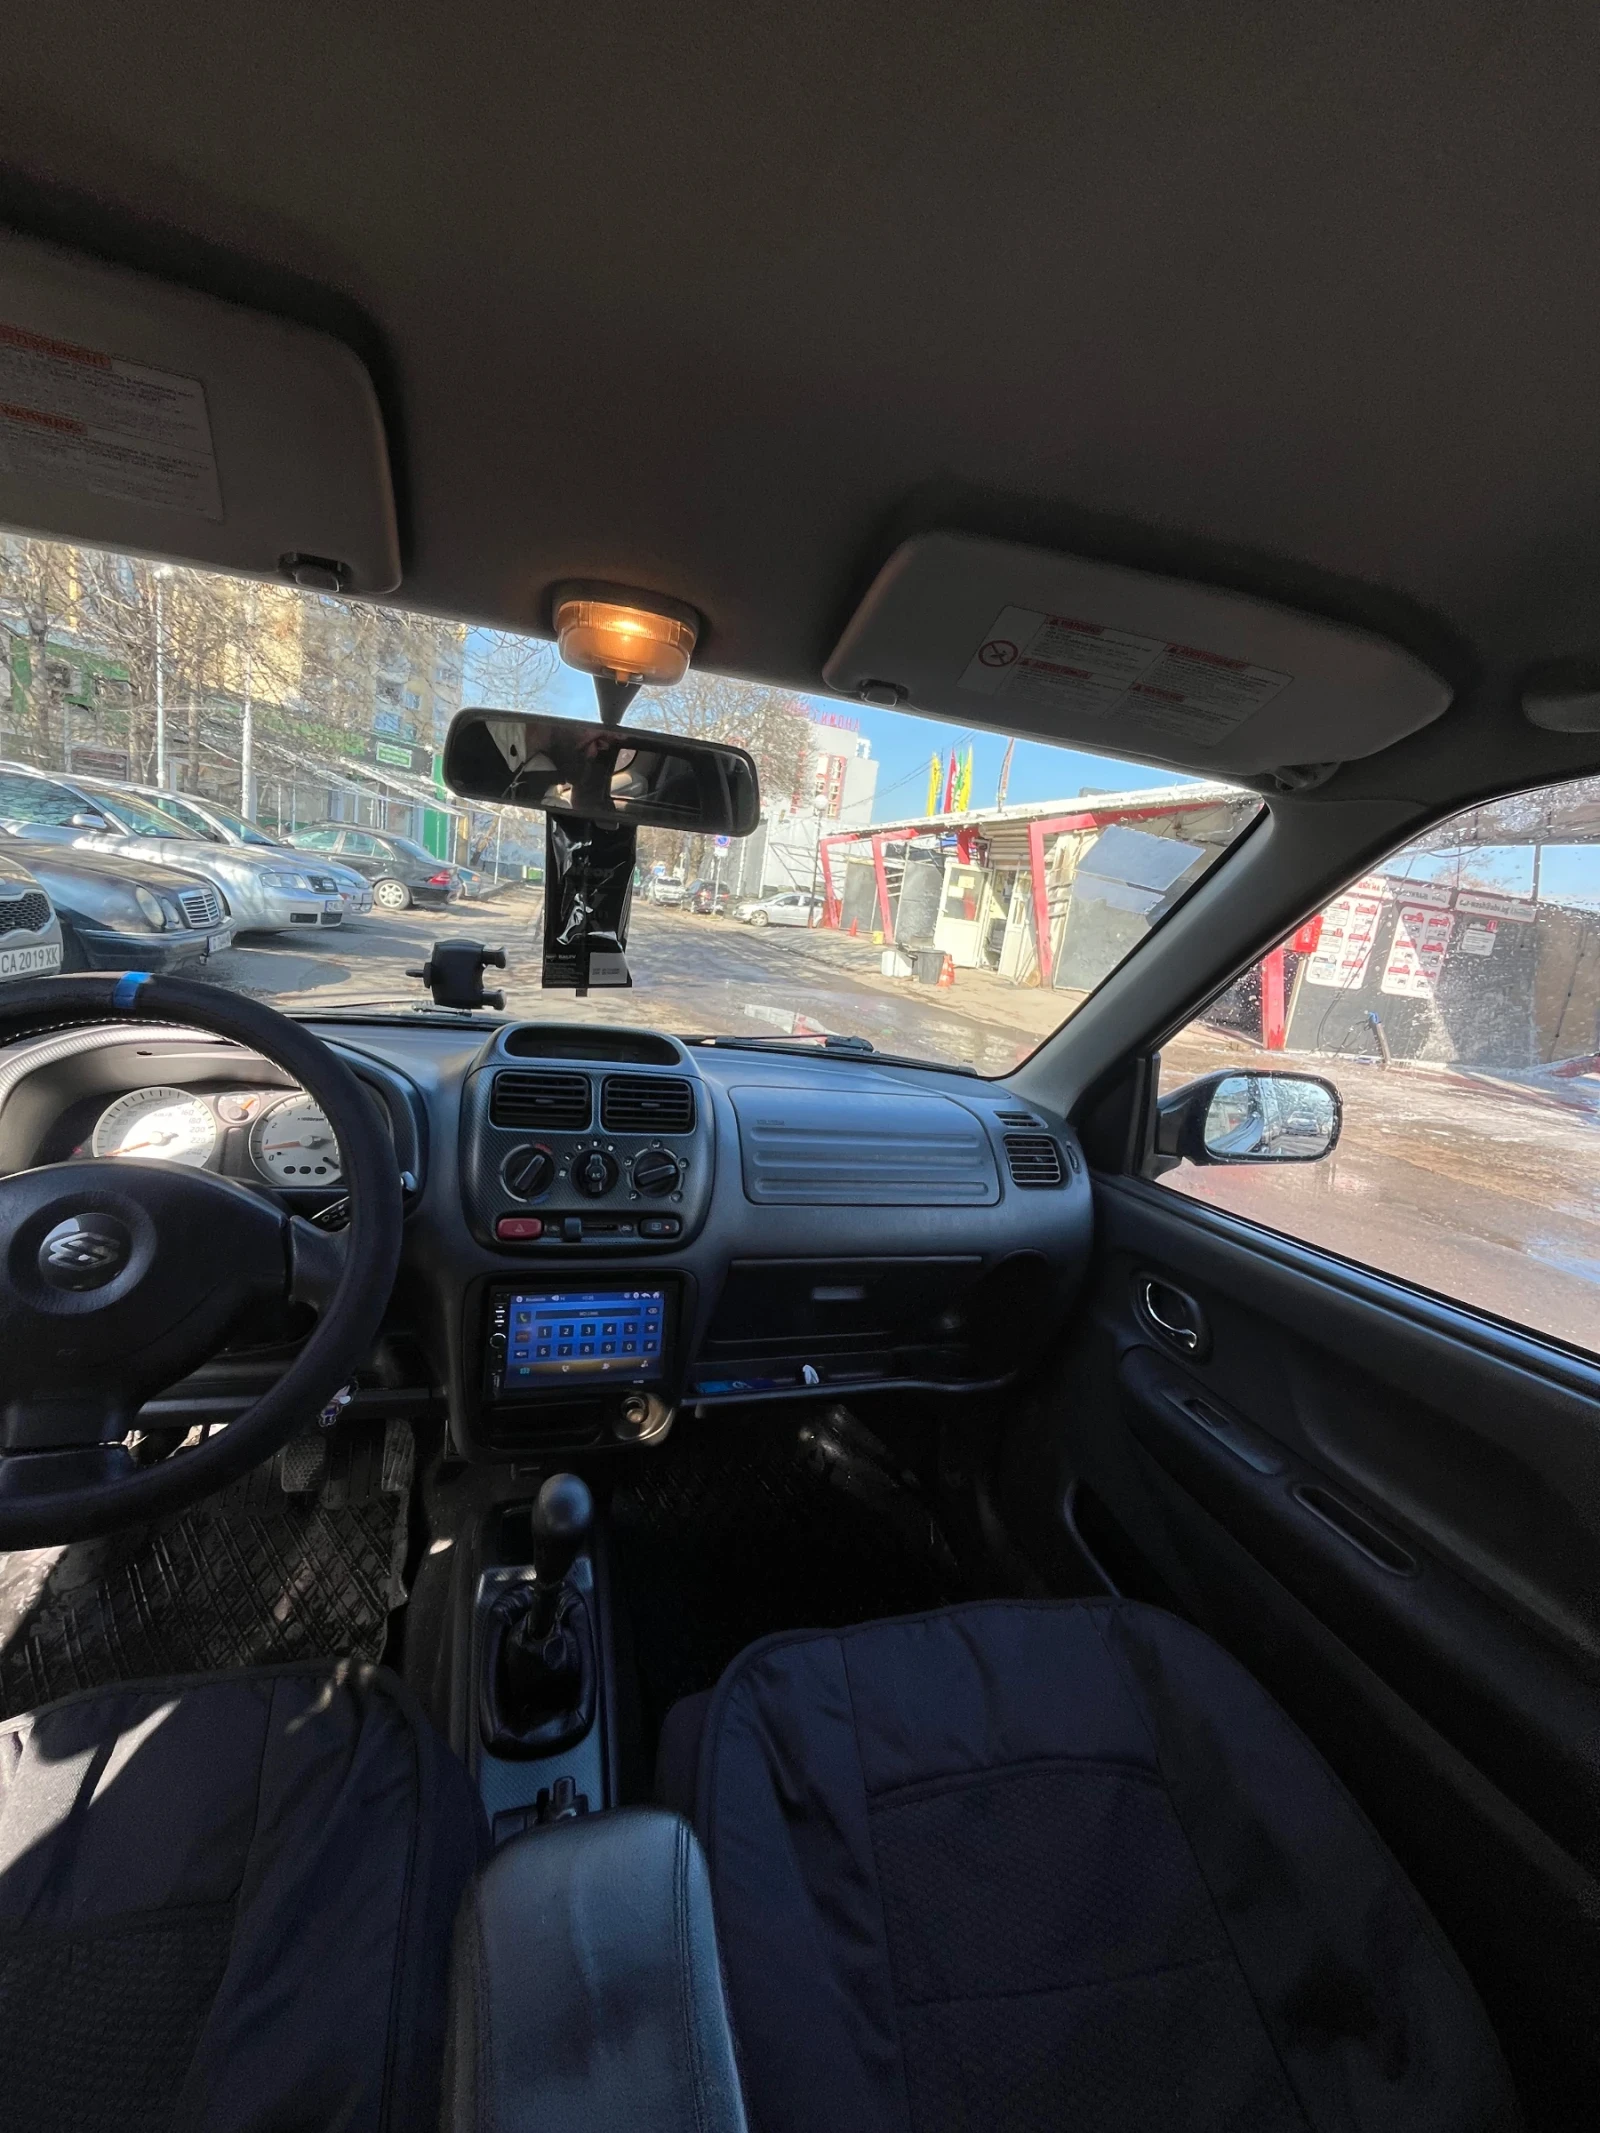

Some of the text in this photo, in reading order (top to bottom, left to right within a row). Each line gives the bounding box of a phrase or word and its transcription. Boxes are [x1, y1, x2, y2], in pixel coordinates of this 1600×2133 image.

[2, 947, 58, 973] CA 2019 XK
[268, 1153, 275, 1162] 0
[541, 1347, 546, 1355] 6
[563, 1346, 568, 1354] 7
